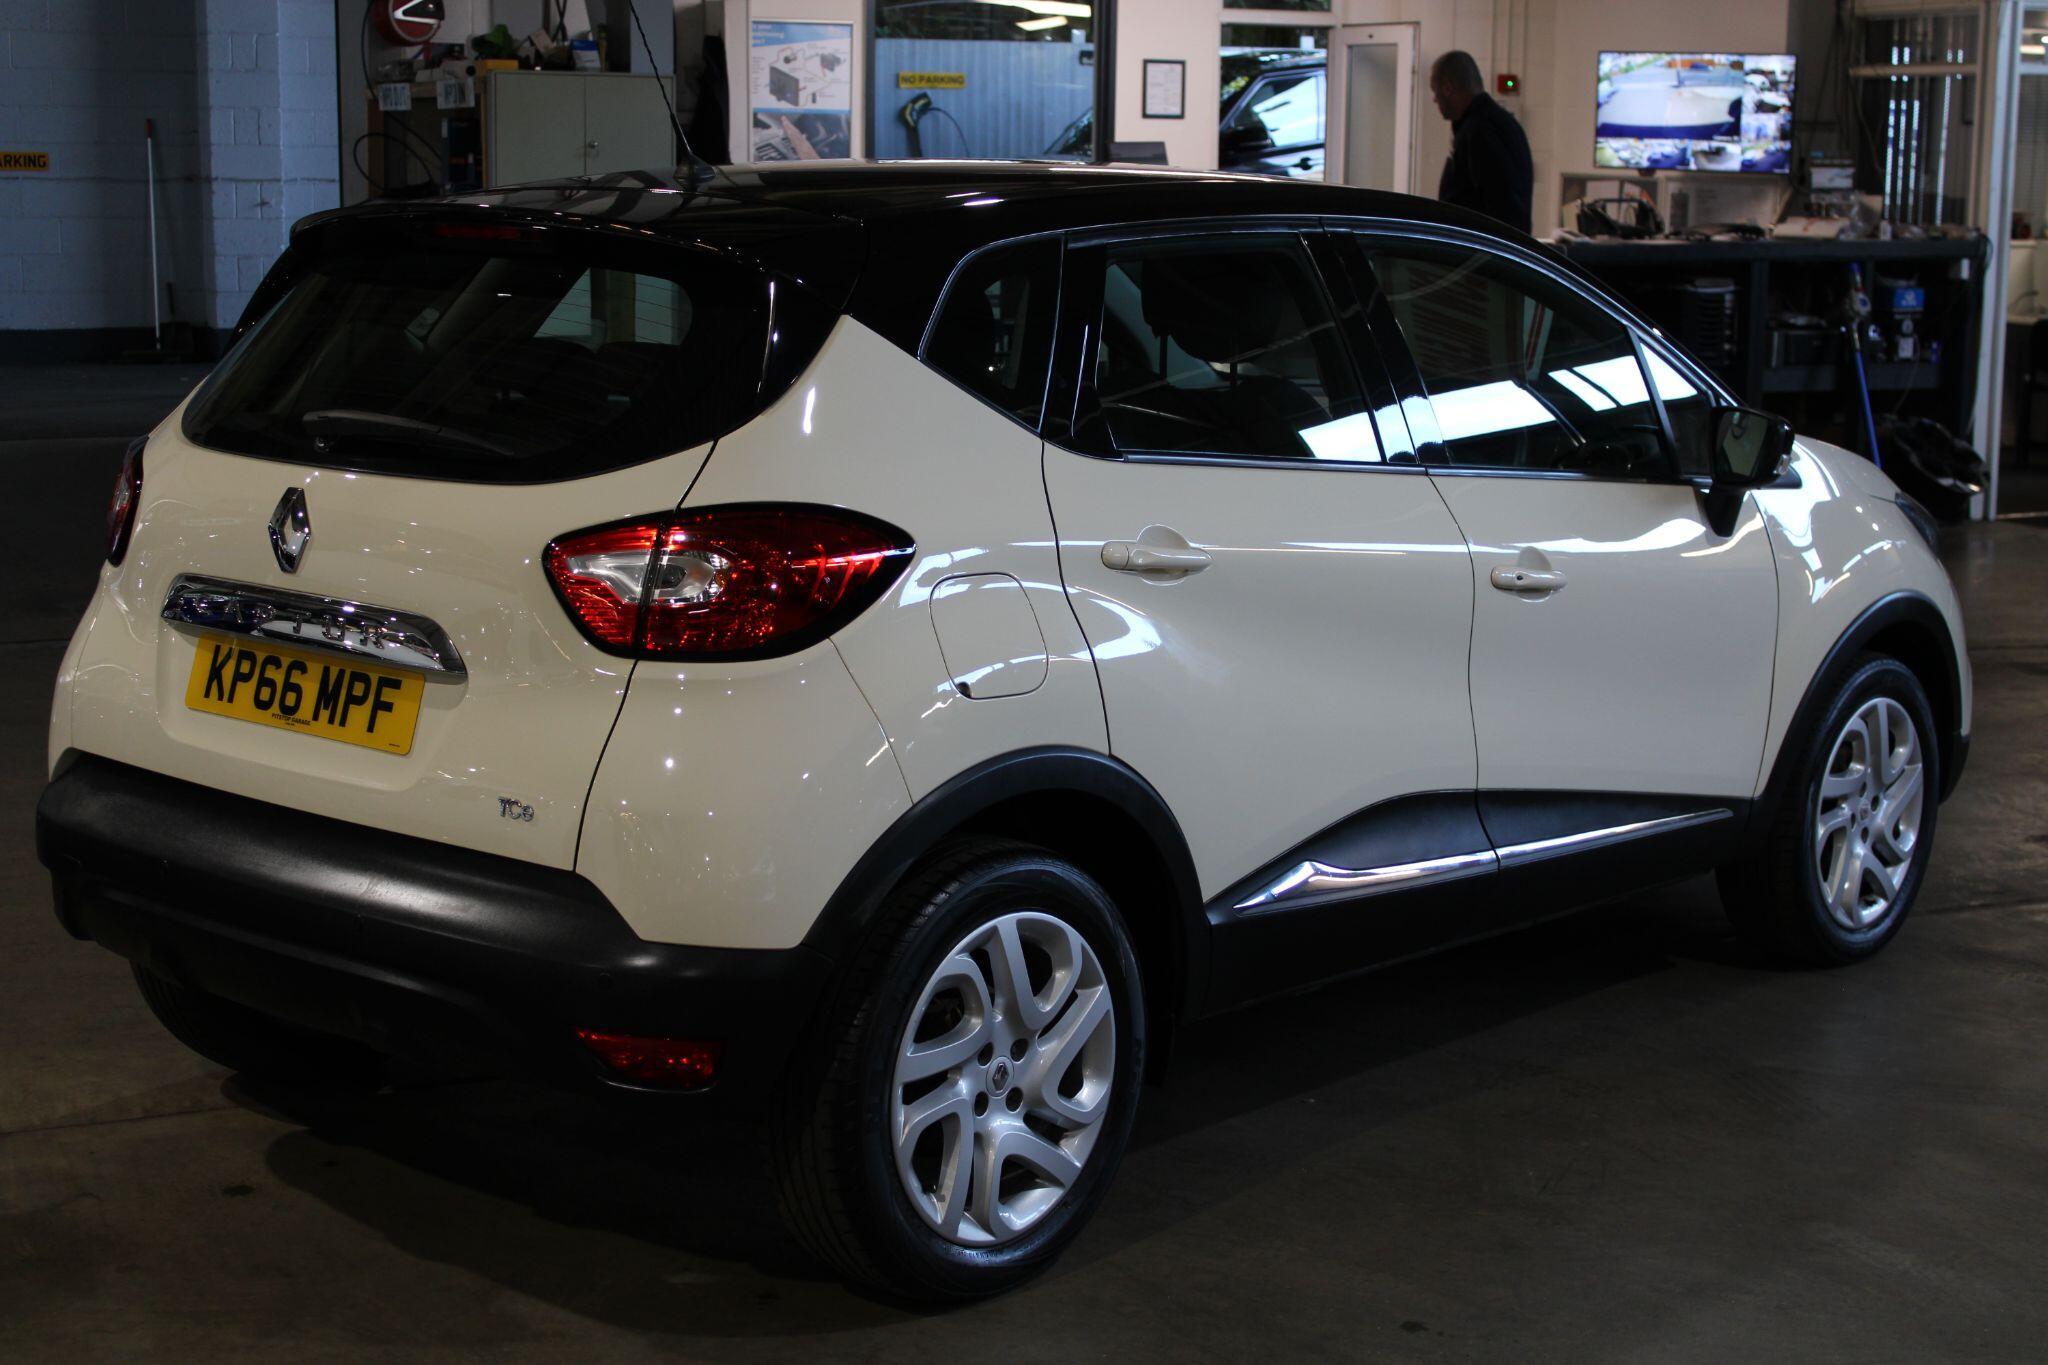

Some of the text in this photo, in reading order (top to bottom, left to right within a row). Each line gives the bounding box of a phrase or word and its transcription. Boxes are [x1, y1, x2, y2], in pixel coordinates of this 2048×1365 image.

[900, 74, 965, 84] NO PARKING
[203, 644, 403, 733] KP66 MPF
